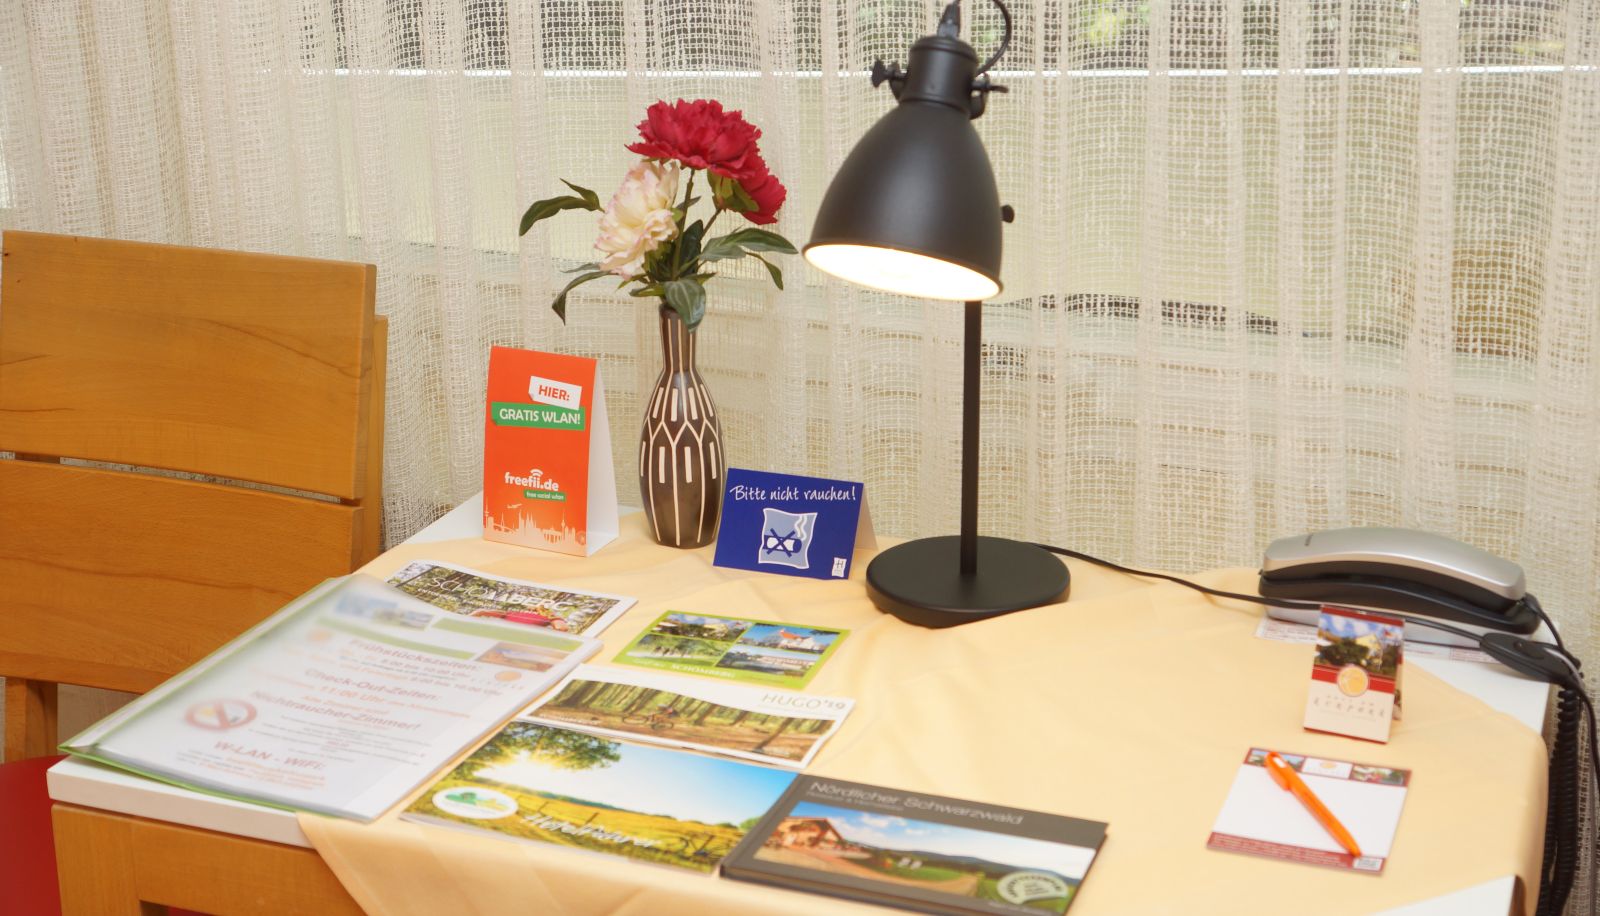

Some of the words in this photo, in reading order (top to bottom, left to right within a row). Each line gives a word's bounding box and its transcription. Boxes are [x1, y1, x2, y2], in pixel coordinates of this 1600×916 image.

[538, 384, 570, 401] HIER:
[499, 408, 539, 422] GRATIS
[541, 410, 581, 425] WLAN!
[504, 471, 559, 491] freefii.de
[730, 485, 766, 500] Bitte
[770, 487, 799, 500] nicht
[804, 486, 856, 501] rauchen!
[809, 780, 900, 805] Nördlicher
[904, 796, 1024, 826] Schwarzwald
